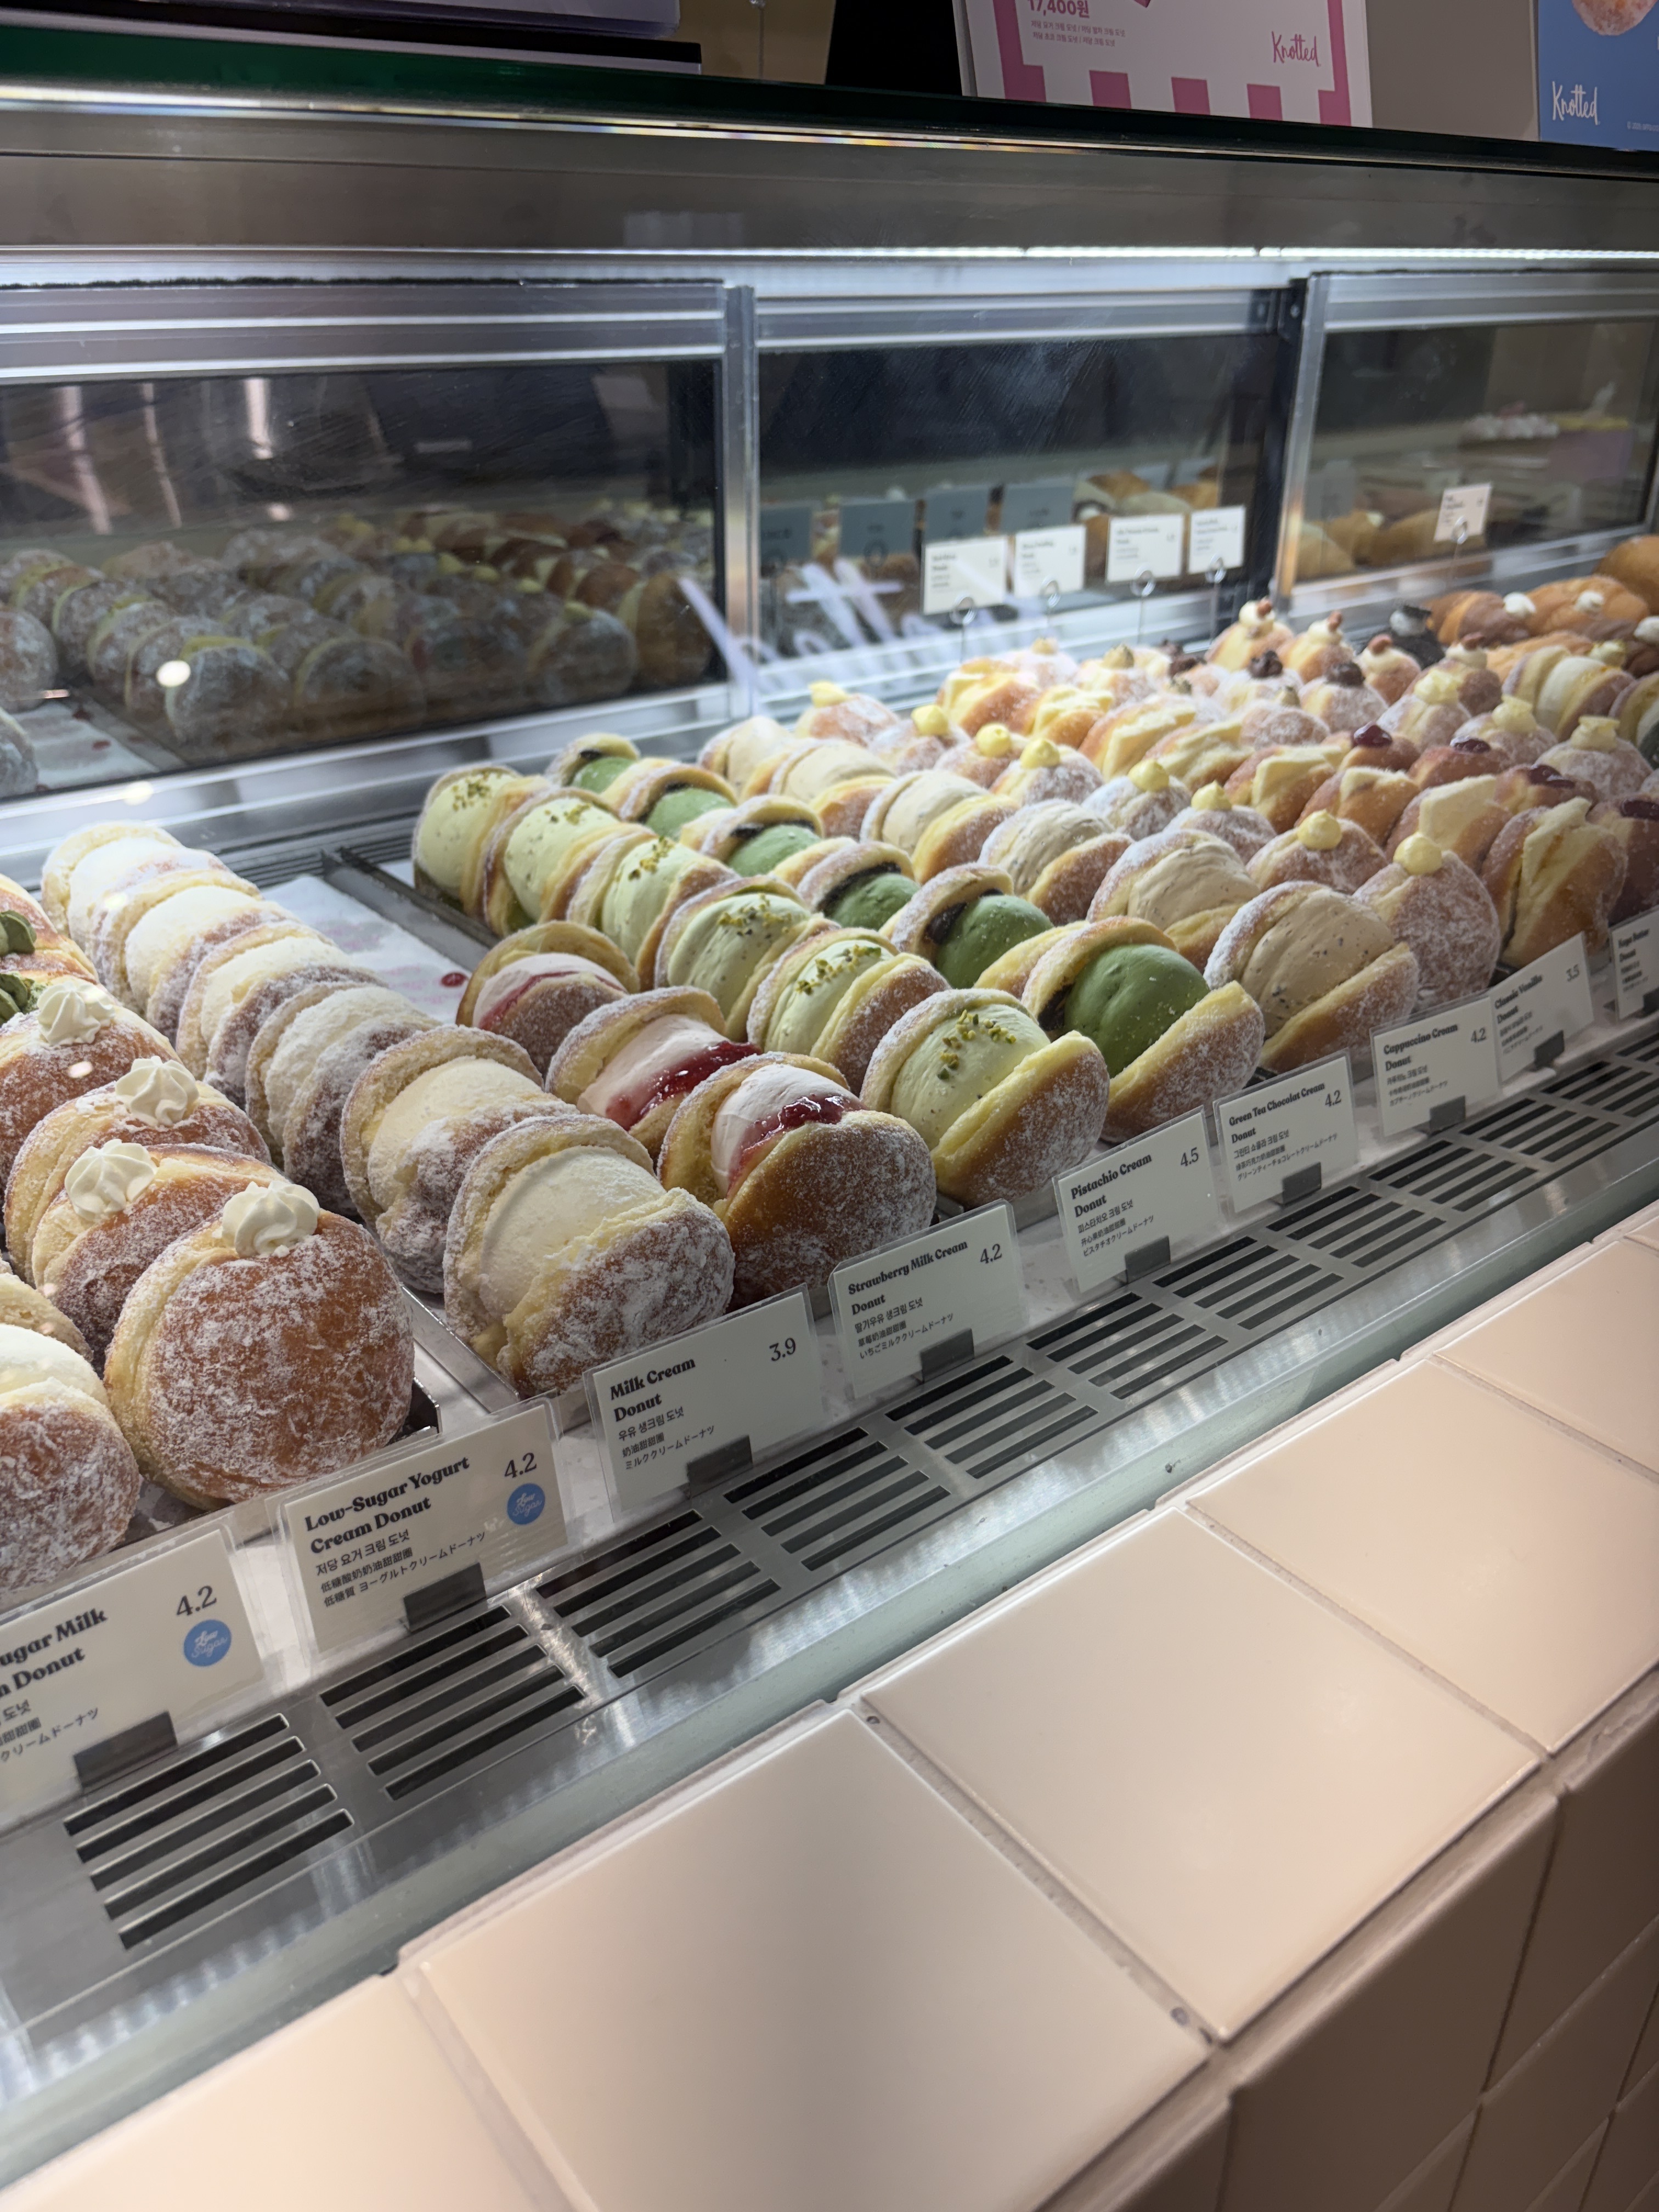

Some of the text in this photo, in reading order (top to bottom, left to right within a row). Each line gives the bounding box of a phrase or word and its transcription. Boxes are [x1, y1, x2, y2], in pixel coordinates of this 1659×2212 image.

[1027, 0, 1090, 18] 17,400원
[1271, 31, 1319, 67] Knotted
[1552, 81, 1599, 126] Knotted
[1497, 1006, 1519, 1024] Donut
[1384, 1033, 1431, 1055] Cappuccino
[1431, 1024, 1458, 1039] Cream
[1471, 1028, 1487, 1043] 4.2
[1385, 1056, 1411, 1071] Donut
[1229, 1083, 1342, 1126] Green Tea Chocolat Cream 4.2
[1231, 1127, 1256, 1144] Donut
[1267, 1133, 1278, 1146] 크림
[1279, 1128, 1290, 1141] 도넛
[1071, 1147, 1200, 1200] Pistachio Cream 4.5
[1074, 1194, 1107, 1218] Donut
[1077, 1199, 1134, 1234] 피스타치오 크림 도넛
[848, 1241, 1003, 1295] Strawberry Milk Cream 4.2
[851, 1294, 886, 1316] Donut
[854, 1296, 924, 1334] 딸기우유 생크림 도넛
[860, 1312, 953, 1359] いちごミルククリームドーナツ
[610, 1337, 797, 1400] Milk Cream 3.9
[613, 1393, 663, 1422] Donut
[618, 1406, 685, 1442] 우유 생크림 도넛
[622, 1432, 665, 1458] 奶油甜甜圈
[625, 1425, 714, 1470] ミルククリームドーナツ
[304, 1452, 538, 1532] Low-Sugar Yogurt 4.2
[512, 1500, 543, 1517] Sugar
[310, 1497, 432, 1554] Cream Donut
[316, 1528, 410, 1576] 저당 요거 크림 도넛
[320, 1547, 413, 1593] 低糖酸奶奶油甜甜圈
[0, 1584, 217, 1667] ugar Milk 4.2
[12, 1646, 86, 1691] Donut
[3, 1699, 32, 1722] 도넛
[1, 1707, 99, 1763] クリームドーナツ
